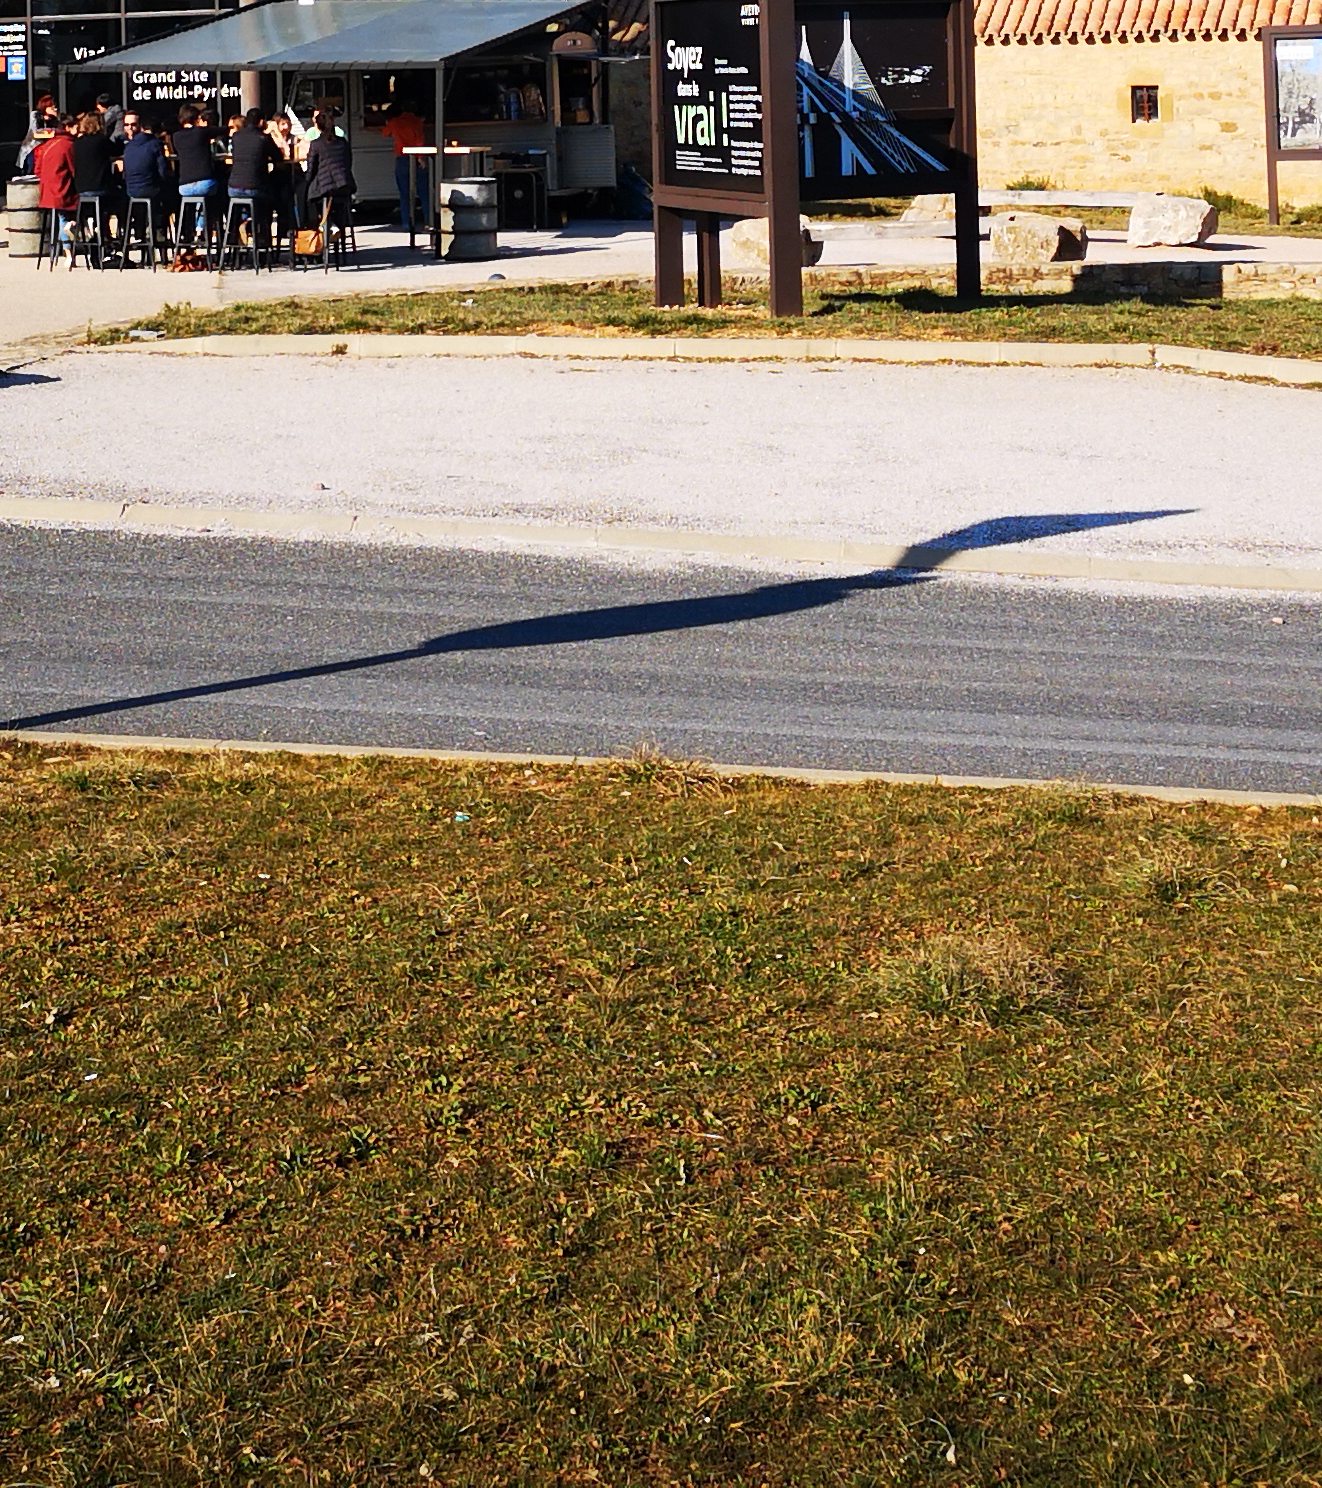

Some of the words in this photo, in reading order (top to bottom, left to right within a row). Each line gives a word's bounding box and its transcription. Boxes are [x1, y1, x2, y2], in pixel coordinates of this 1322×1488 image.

[667, 40, 703, 78] Soyez
[132, 70, 176, 84] Grand
[180, 70, 209, 83] Site
[132, 86, 152, 100] de
[692, 80, 700, 96] le
[674, 90, 716, 146] vrai
[721, 91, 728, 146] !
